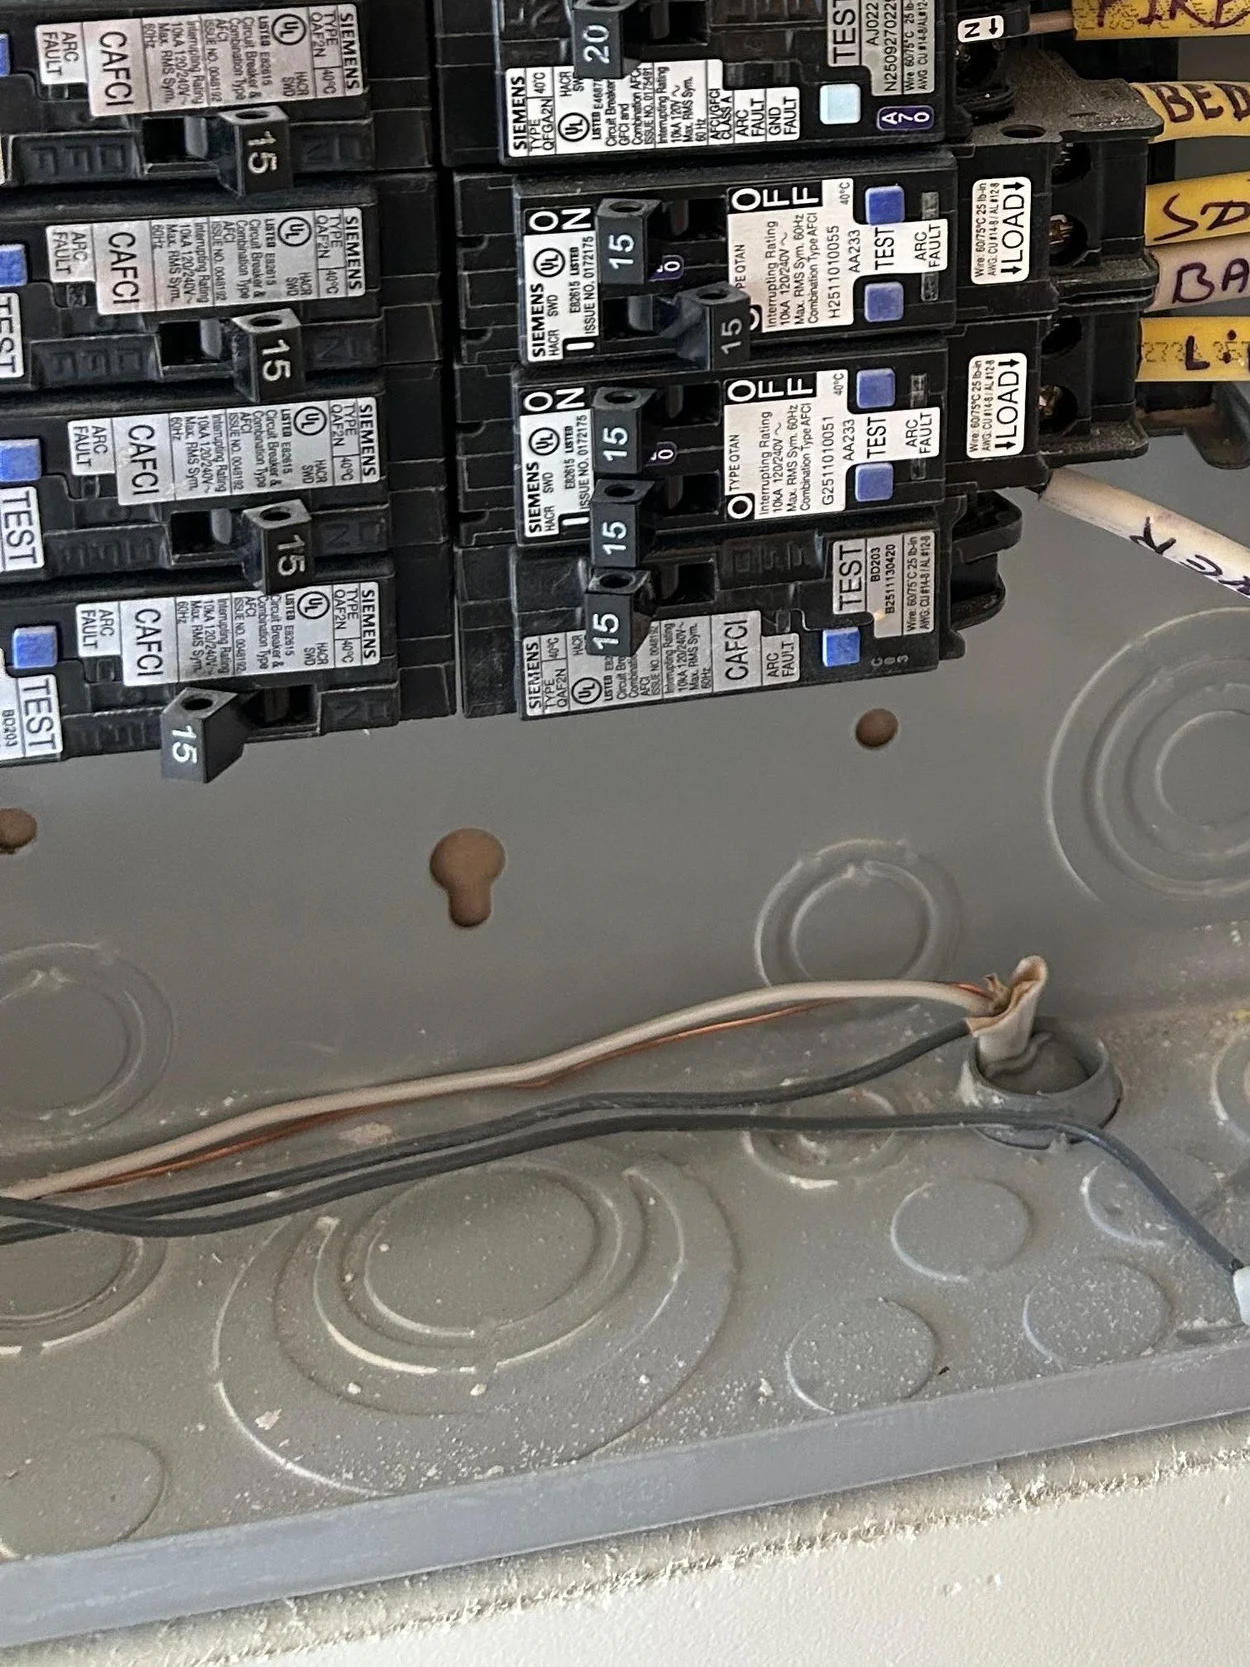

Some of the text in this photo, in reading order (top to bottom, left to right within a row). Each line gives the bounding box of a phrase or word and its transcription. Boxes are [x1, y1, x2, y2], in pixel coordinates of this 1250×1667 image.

[323, 10, 338, 46] TYPE
[583, 23, 610, 65] 20
[867, 2, 880, 46] AJ022
[964, 22, 981, 36] N
[43, 32, 62, 77] FAULT
[61, 32, 79, 63] ARC
[99, 31, 134, 106] CAFCI
[340, 13, 359, 90] SIEMENS
[512, 76, 528, 151] SIEMENS
[247, 130, 278, 174] 15
[529, 207, 592, 231] ON
[731, 186, 819, 211] OFF
[71, 232, 89, 264] ARC
[874, 227, 895, 270] TEST
[915, 232, 927, 260] ARC
[928, 224, 941, 268] FAULT
[1001, 194, 1025, 264] LOAD
[52, 231, 72, 275] FAULT
[108, 231, 140, 305] CAFCI
[346, 216, 363, 290] SIEMENS
[608, 234, 634, 269] 15
[734, 244, 746, 274] QTAN
[827, 225, 840, 319] H2511010055
[848, 229, 861, 273] AA233
[530, 283, 546, 357] SIEMENS
[721, 318, 742, 355] 15
[262, 339, 291, 382] 15
[524, 387, 585, 411] ON
[727, 378, 814, 402] OFF
[997, 371, 1019, 439] LOAD
[90, 425, 108, 456] ARC
[342, 403, 358, 437] TYPE
[359, 403, 377, 477] SIEMENS
[842, 418, 855, 461] AA233
[867, 416, 887, 458] TEST
[906, 419, 919, 448] ARC
[919, 412, 933, 454] FAULT
[73, 425, 93, 470] FAULT
[127, 424, 160, 496] CAFCI
[603, 427, 628, 461] 15
[729, 434, 740, 491] TYPE QTAN
[822, 415, 835, 506] G2511010051
[526, 462, 542, 533] SIEMENS
[1, 490, 37, 565] TEST
[602, 522, 627, 555] 15
[277, 534, 306, 577] 15
[870, 546, 881, 583] BD203
[838, 546, 863, 612] TEST
[884, 542, 896, 614] B2511130420
[98, 609, 114, 638] ARC
[345, 588, 359, 620] TYPE
[362, 588, 378, 660] SIEMENS
[81, 609, 98, 649] FAULT
[134, 608, 164, 676] CAFCI
[593, 614, 619, 650] 15
[725, 620, 749, 681] CAFCI
[526, 642, 543, 712] SIEMENS
[766, 653, 779, 679] ARC
[781, 641, 795, 679] FAULT
[22, 677, 58, 751] TEST
[172, 724, 199, 766] 15
